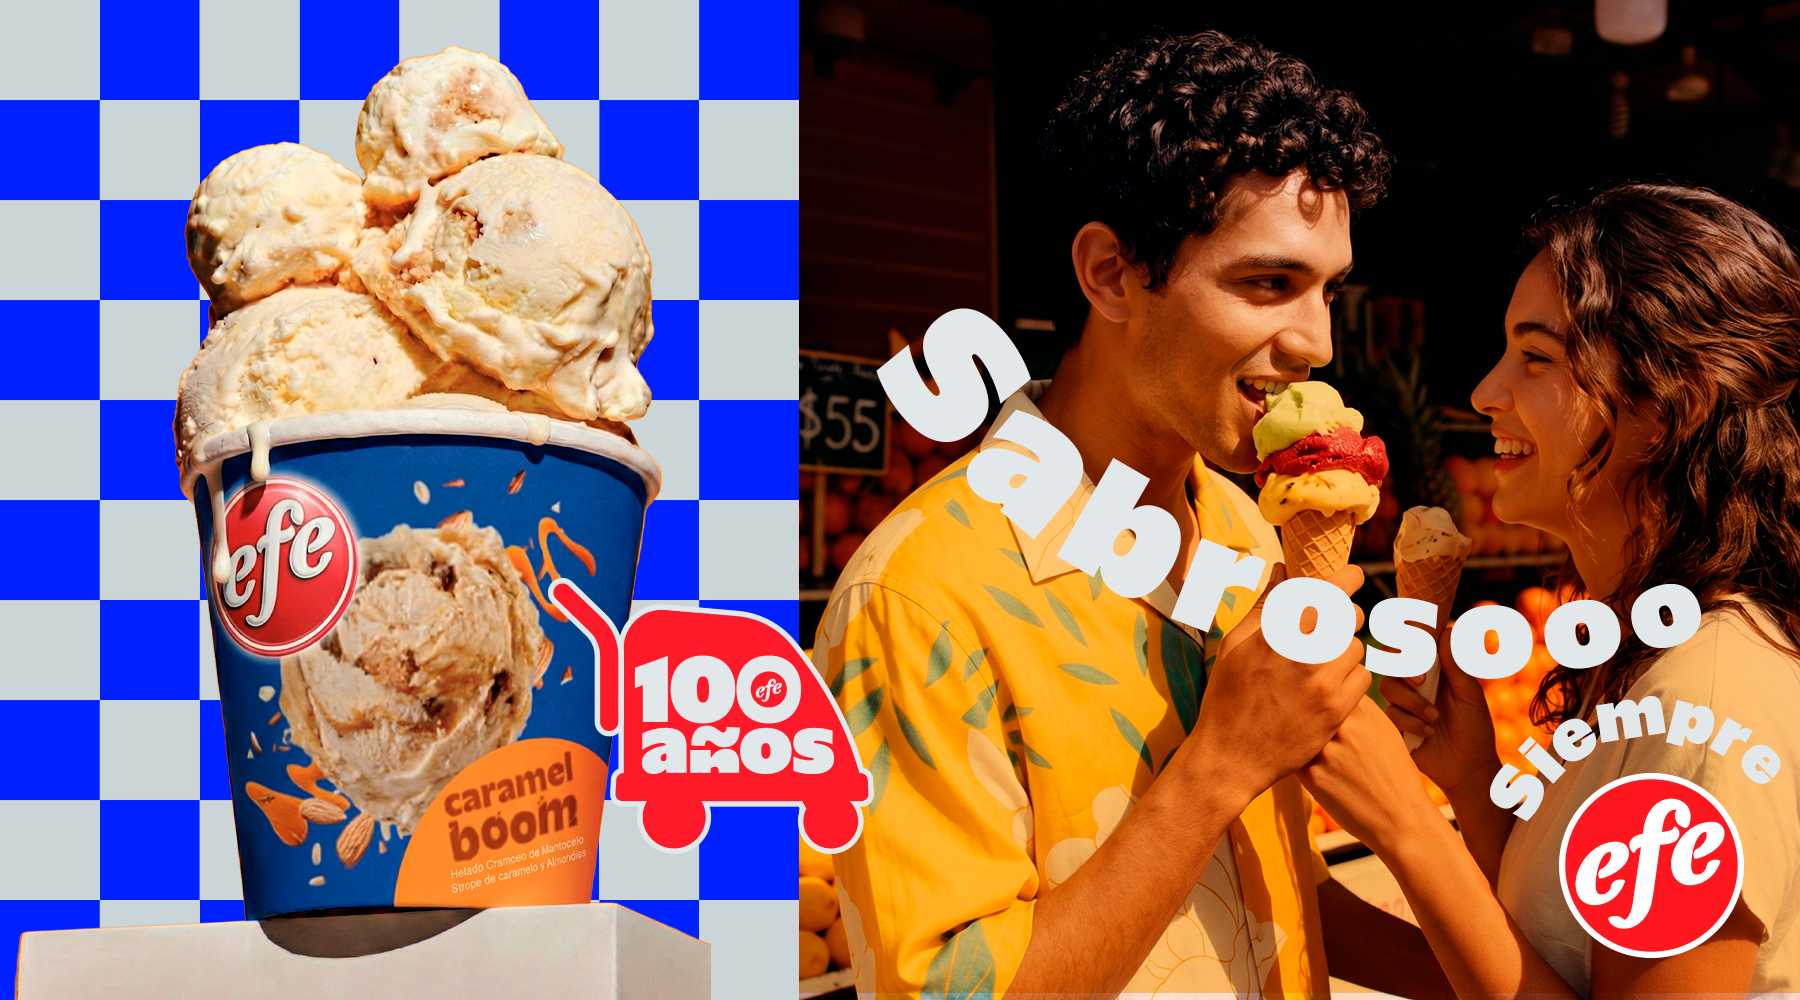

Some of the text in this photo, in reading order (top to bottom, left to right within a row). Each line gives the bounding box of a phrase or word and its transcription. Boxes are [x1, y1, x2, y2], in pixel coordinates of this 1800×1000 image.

[799, 386, 881, 454] $55
[222, 498, 336, 628] efe
[444, 750, 574, 817] caramel
[448, 793, 578, 862] boom
[450, 863, 484, 880] Helado
[529, 848, 540, 860] de
[484, 874, 496, 886] de
[498, 863, 539, 882] caramelo
[540, 862, 546, 873] y
